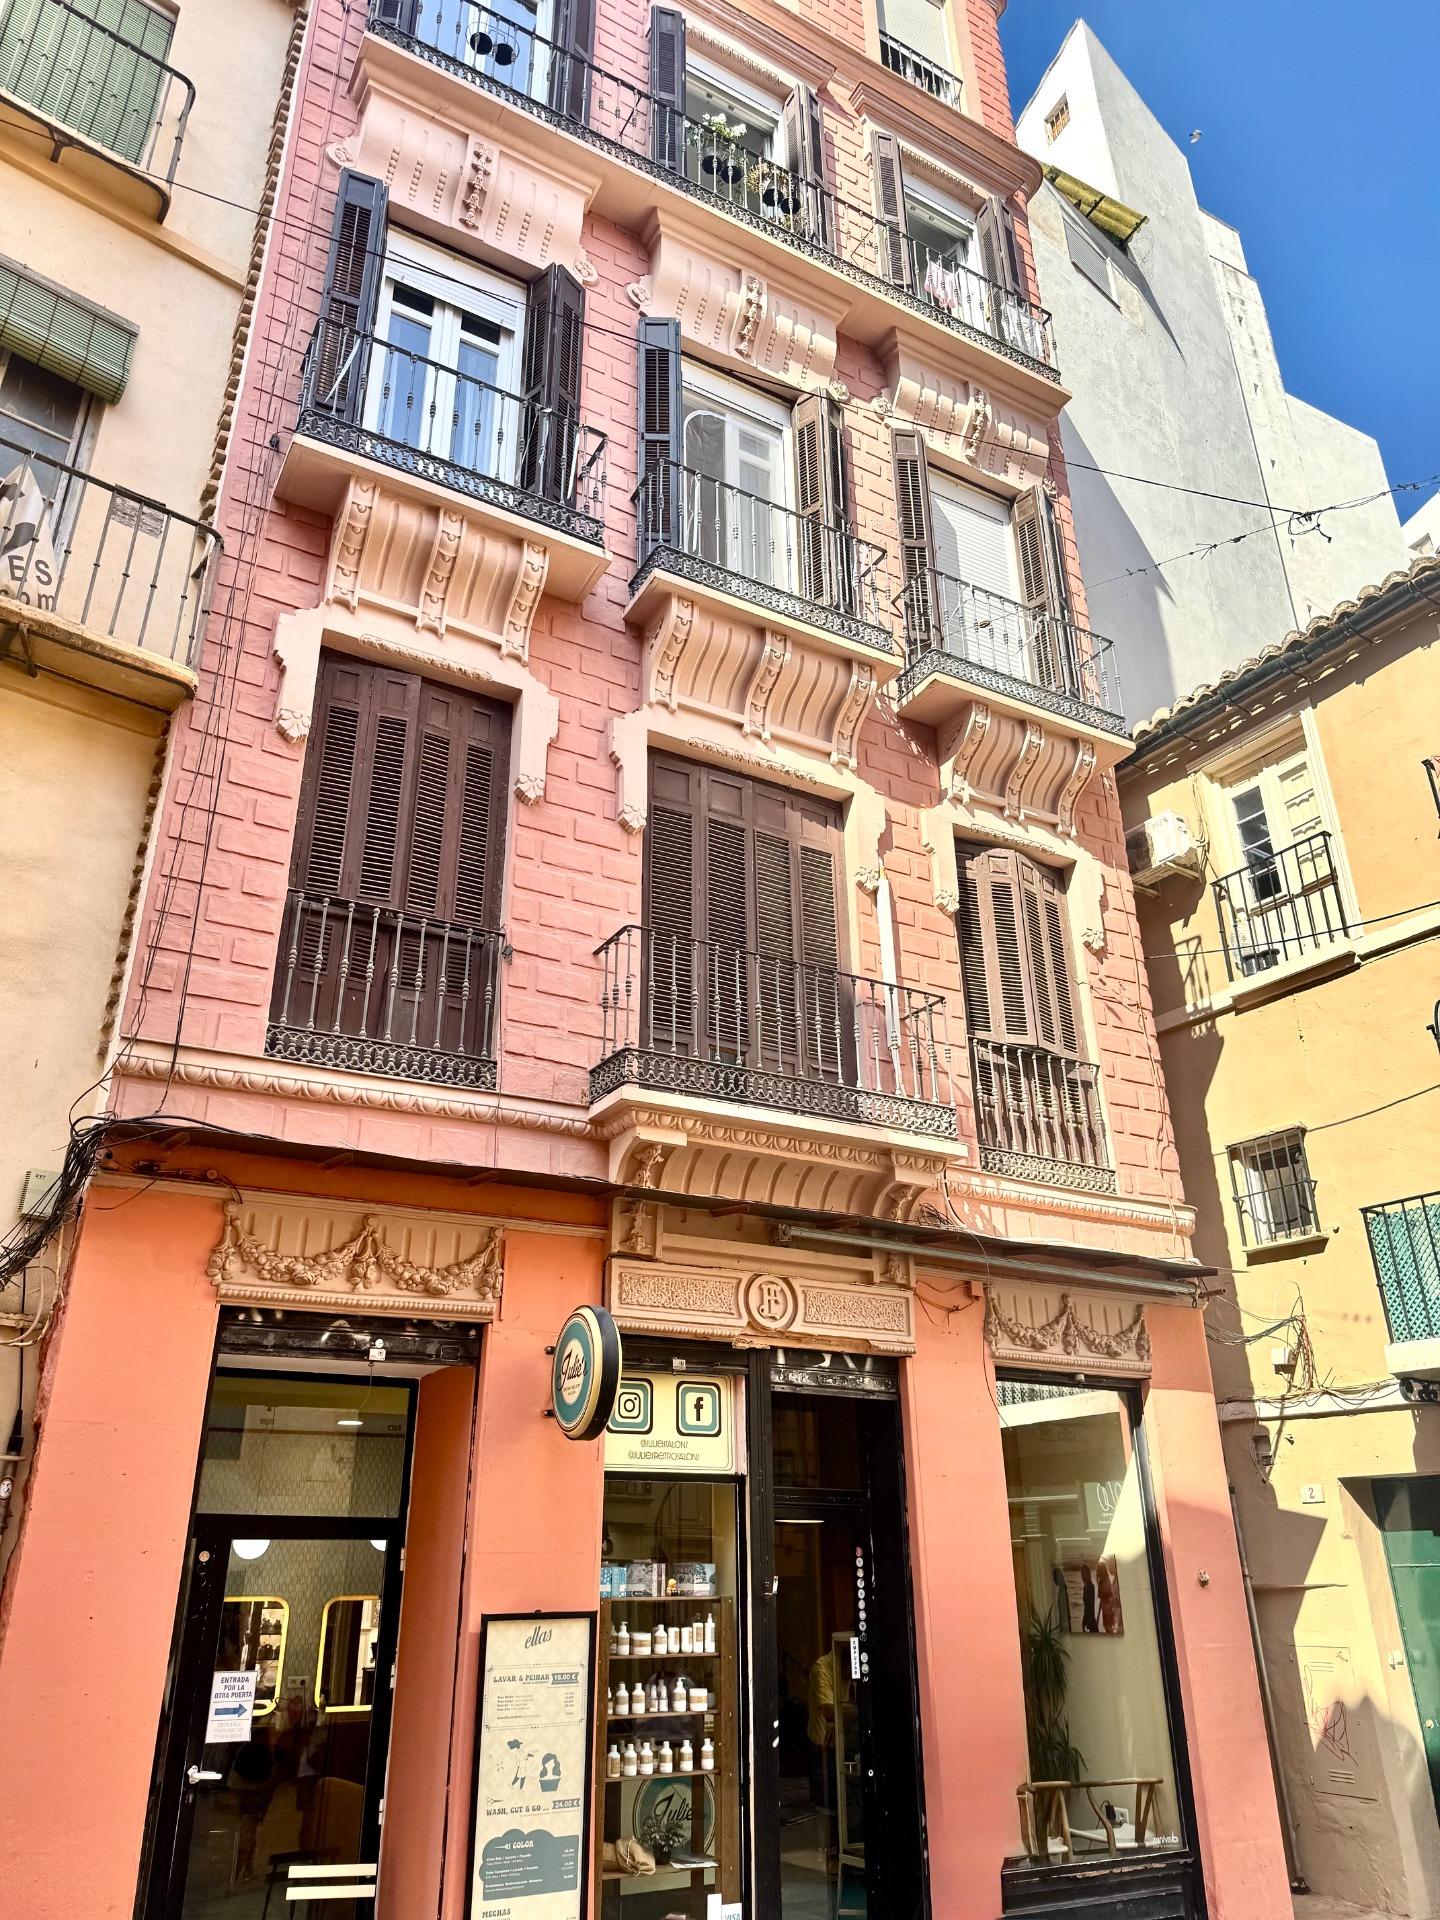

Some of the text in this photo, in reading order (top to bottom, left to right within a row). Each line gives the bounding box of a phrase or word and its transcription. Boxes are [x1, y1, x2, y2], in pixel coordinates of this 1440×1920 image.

[1308, 1487, 1315, 1499] 2
[524, 1625, 553, 1649] ellas
[220, 1676, 250, 1684] ENTRADA
[493, 1675, 516, 1683] LAVAR
[230, 1691, 253, 1699] PUERTA
[512, 1840, 535, 1849] COLOR
[481, 1908, 511, 1919] MECHAS
